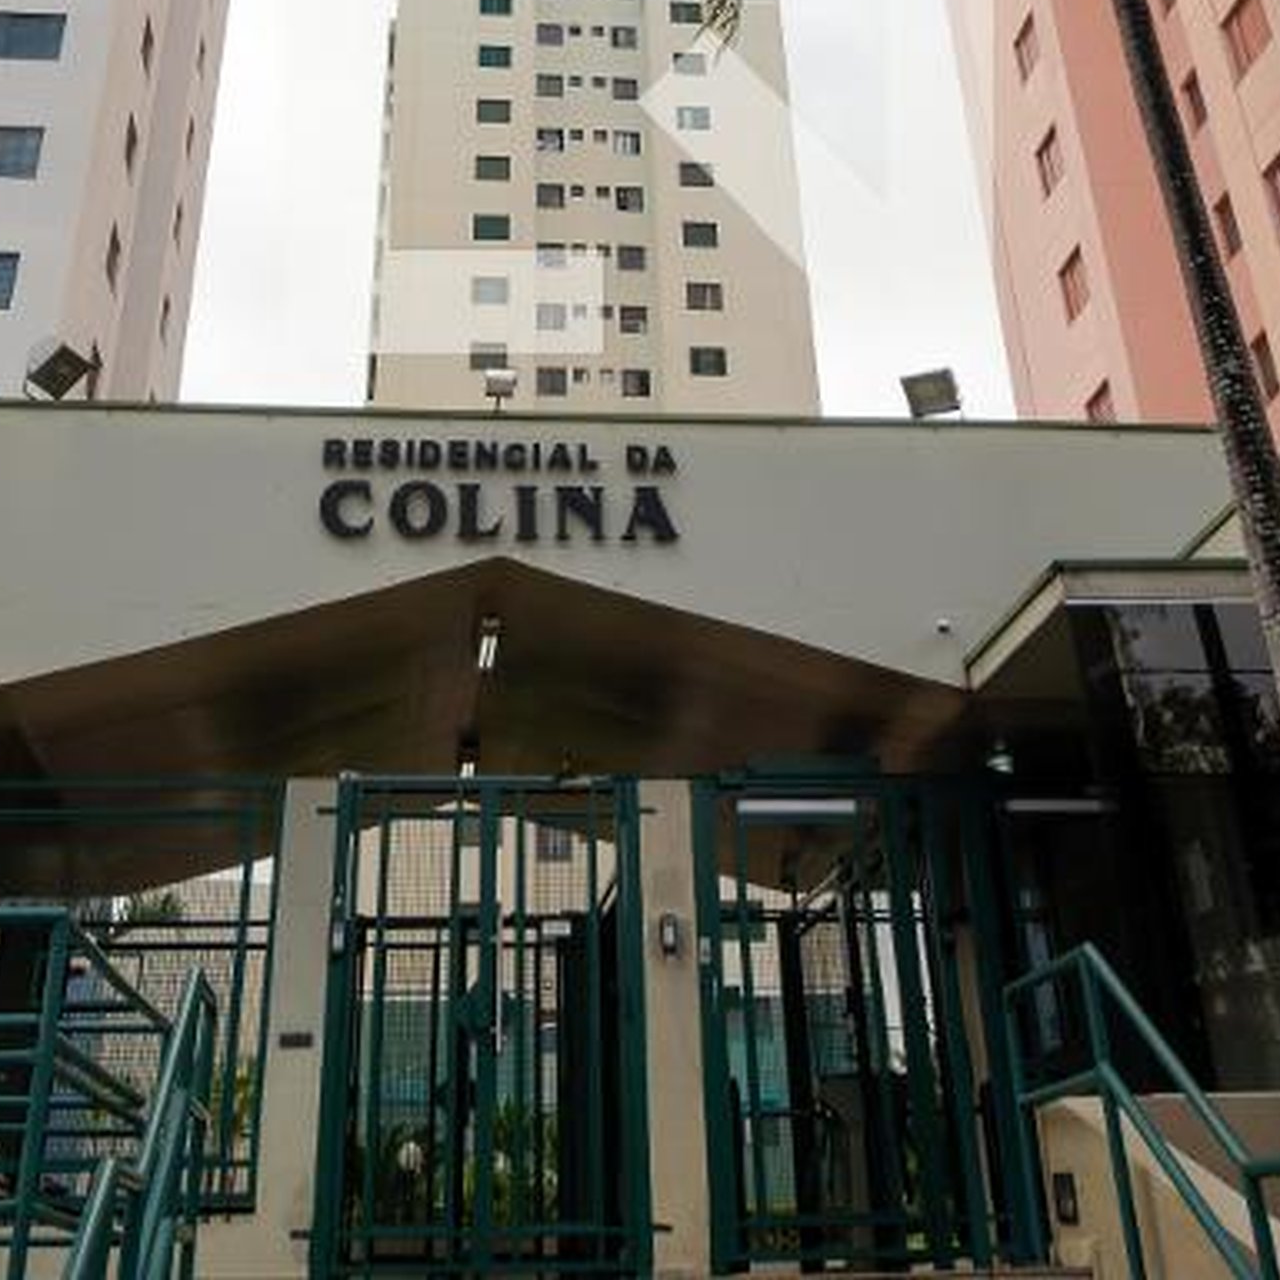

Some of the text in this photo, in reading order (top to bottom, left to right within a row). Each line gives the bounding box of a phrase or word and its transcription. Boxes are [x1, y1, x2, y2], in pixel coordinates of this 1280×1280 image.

[323, 439, 677, 474] RESIDENCIAL DA
[319, 480, 679, 542] COLINA
